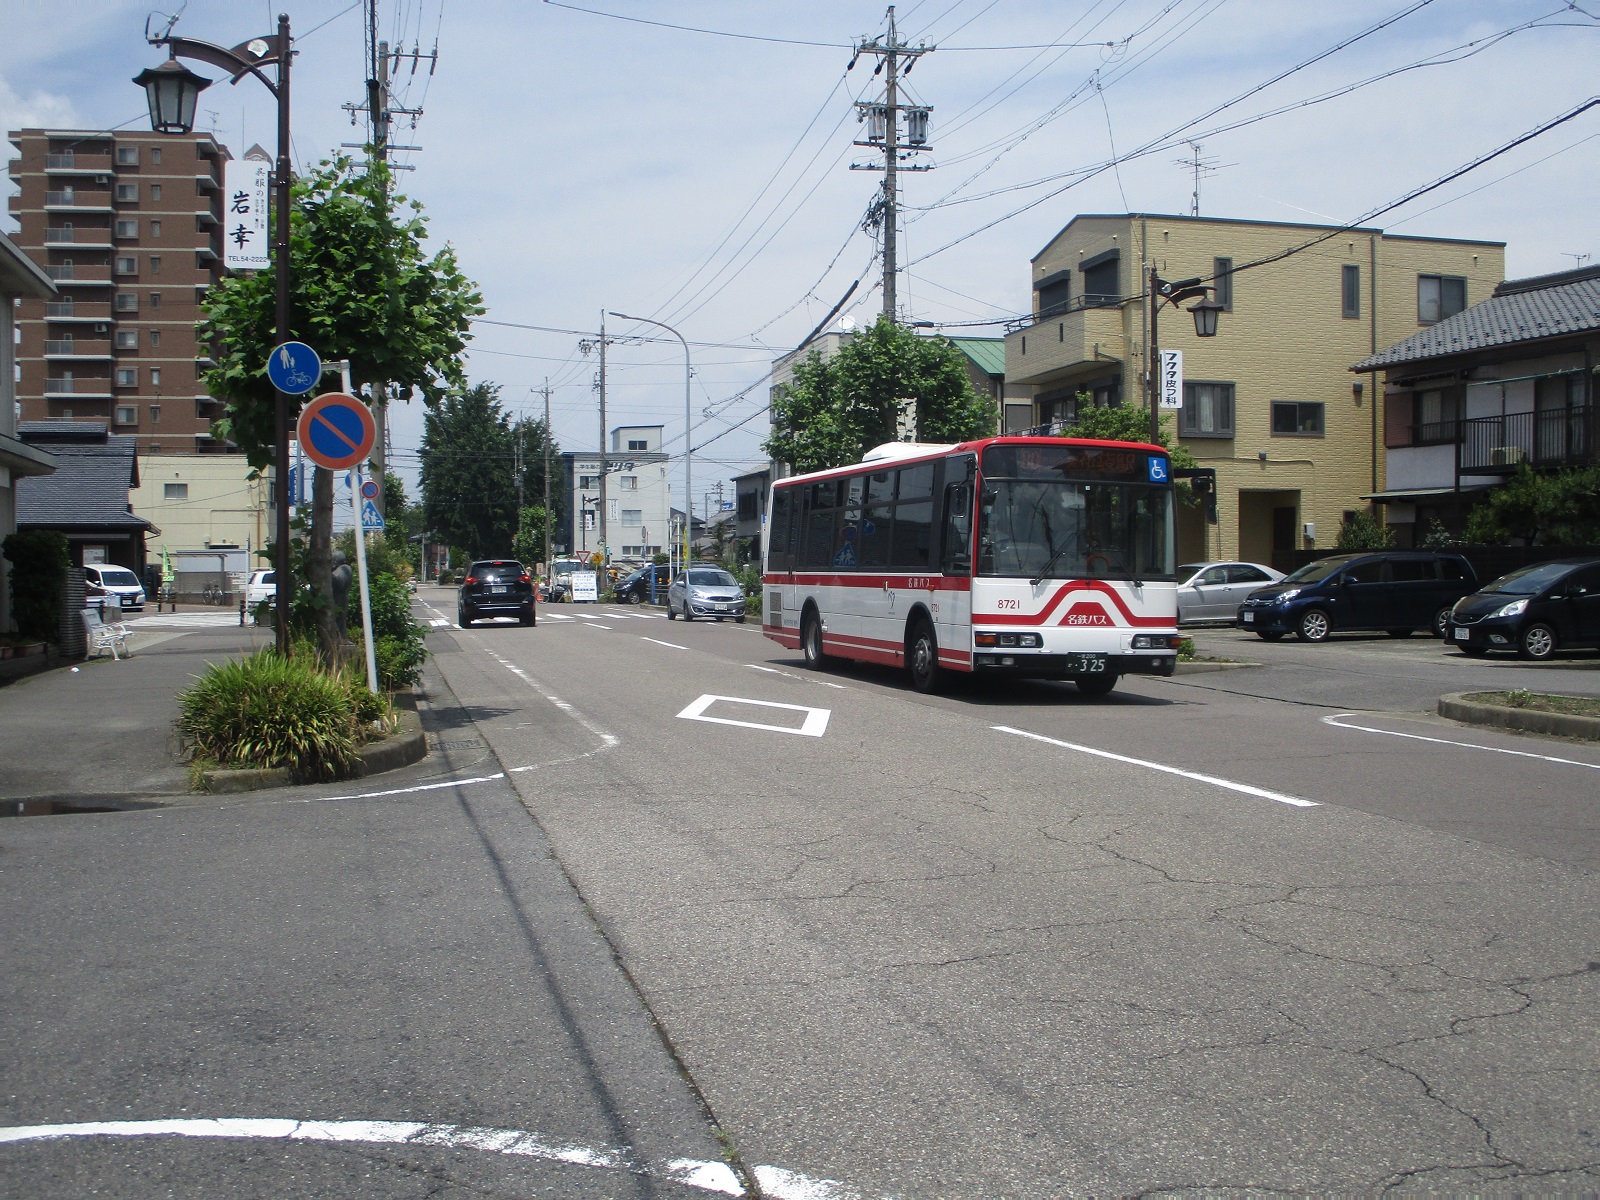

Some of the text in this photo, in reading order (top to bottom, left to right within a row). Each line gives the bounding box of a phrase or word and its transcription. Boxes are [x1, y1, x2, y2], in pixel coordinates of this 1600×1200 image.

[228, 190, 255, 250] 岩幸
[908, 577, 931, 588] 名鉄バス
[997, 599, 1020, 610] 8721
[1067, 614, 1107, 625] 名鉄バス
